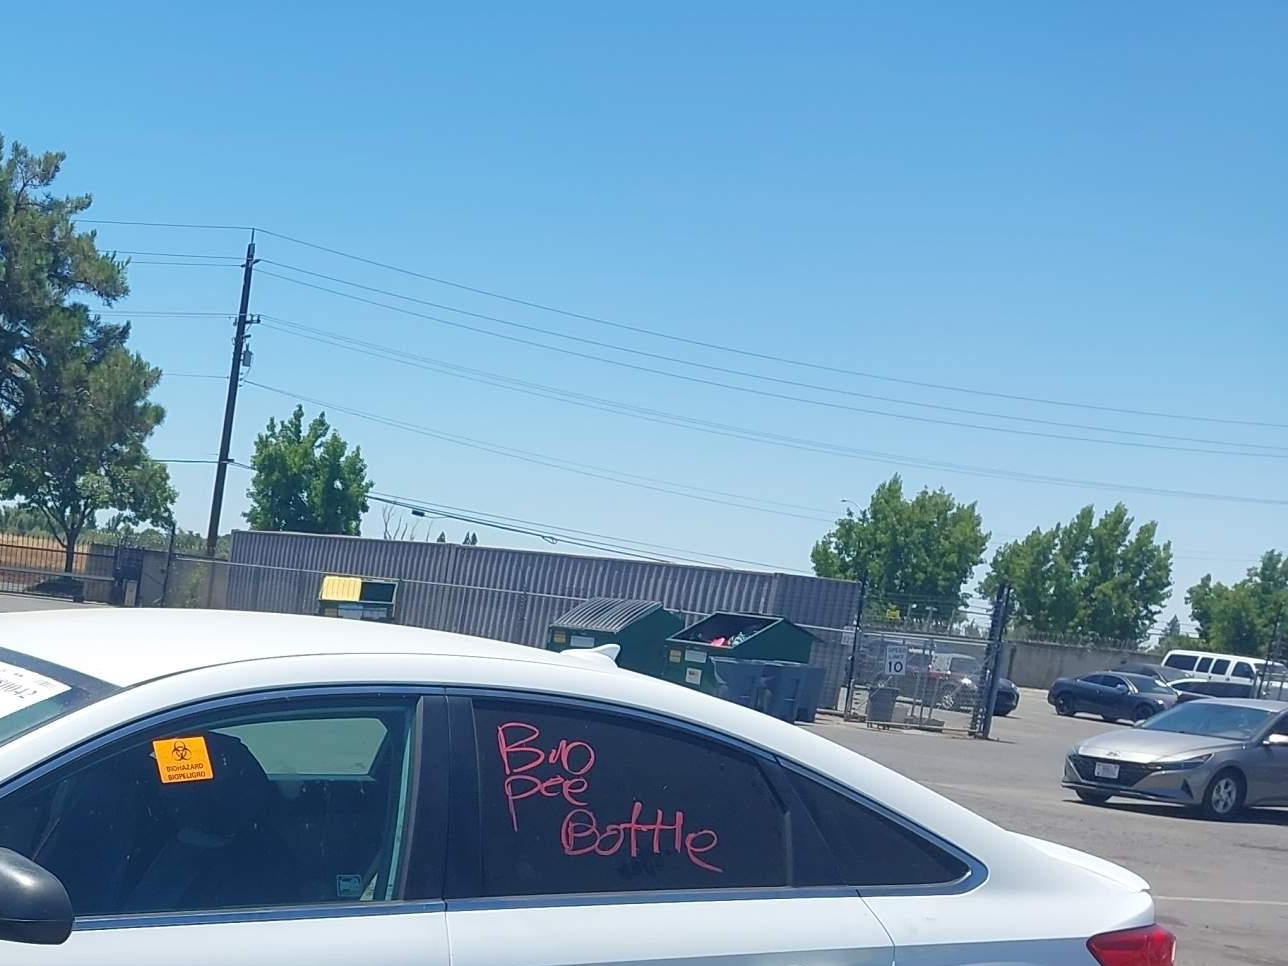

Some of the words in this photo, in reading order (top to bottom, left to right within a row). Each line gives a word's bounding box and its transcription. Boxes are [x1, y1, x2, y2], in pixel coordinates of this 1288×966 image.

[888, 661, 903, 673] 10
[165, 762, 204, 773] BIOHAZARD
[561, 801, 724, 873] Bottle
